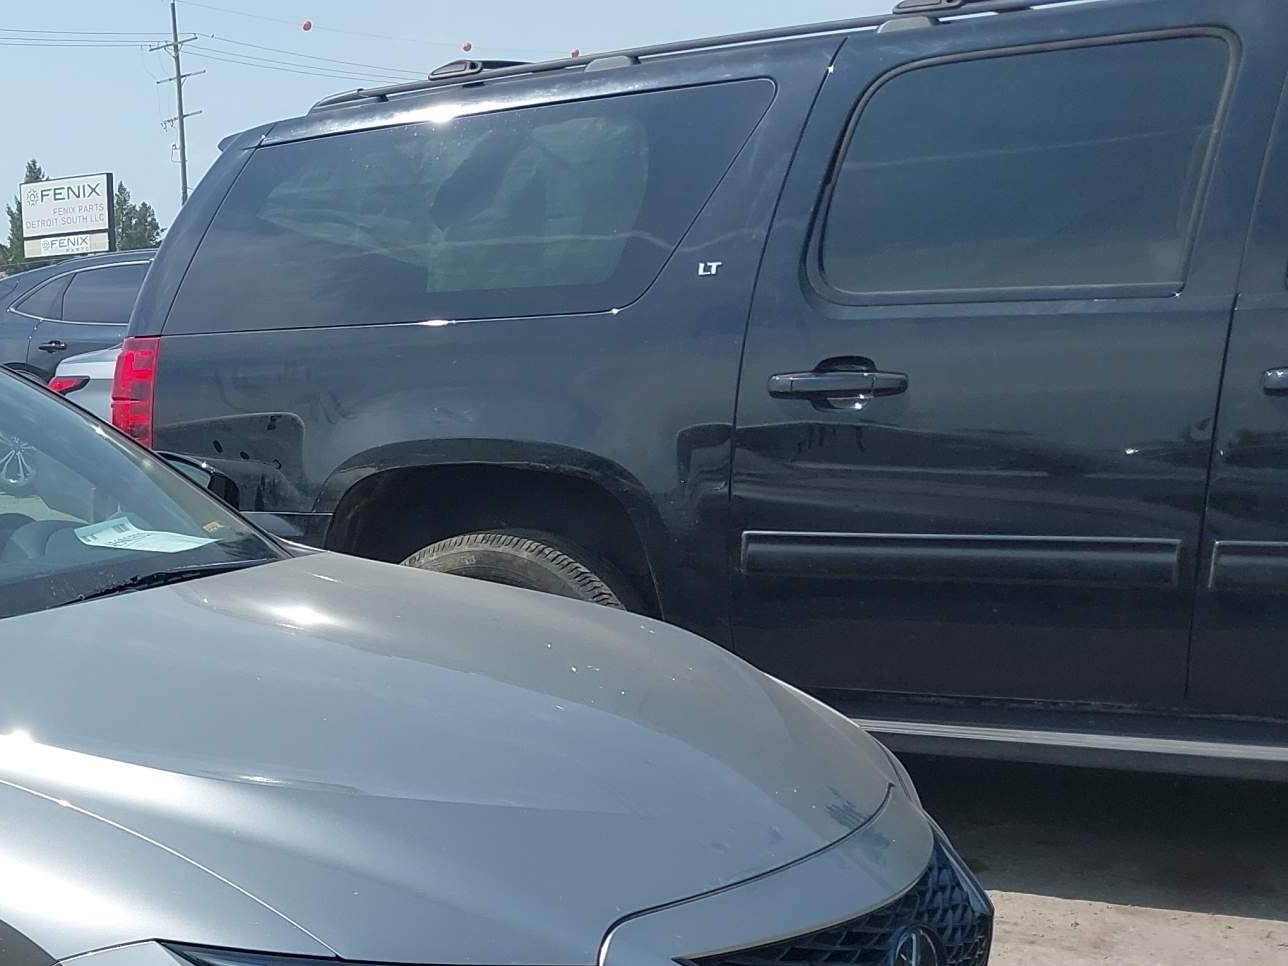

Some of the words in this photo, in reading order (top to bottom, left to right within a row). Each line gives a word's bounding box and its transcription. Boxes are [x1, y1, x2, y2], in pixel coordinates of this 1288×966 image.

[40, 182, 102, 203] FENIX
[52, 206, 76, 216] FENIX
[78, 202, 105, 214] PARTS
[25, 217, 58, 230] DETROIT
[61, 215, 88, 226] SOUTH
[90, 213, 105, 223] LLC
[50, 236, 89, 249] FENIX
[698, 261, 723, 276] LT
